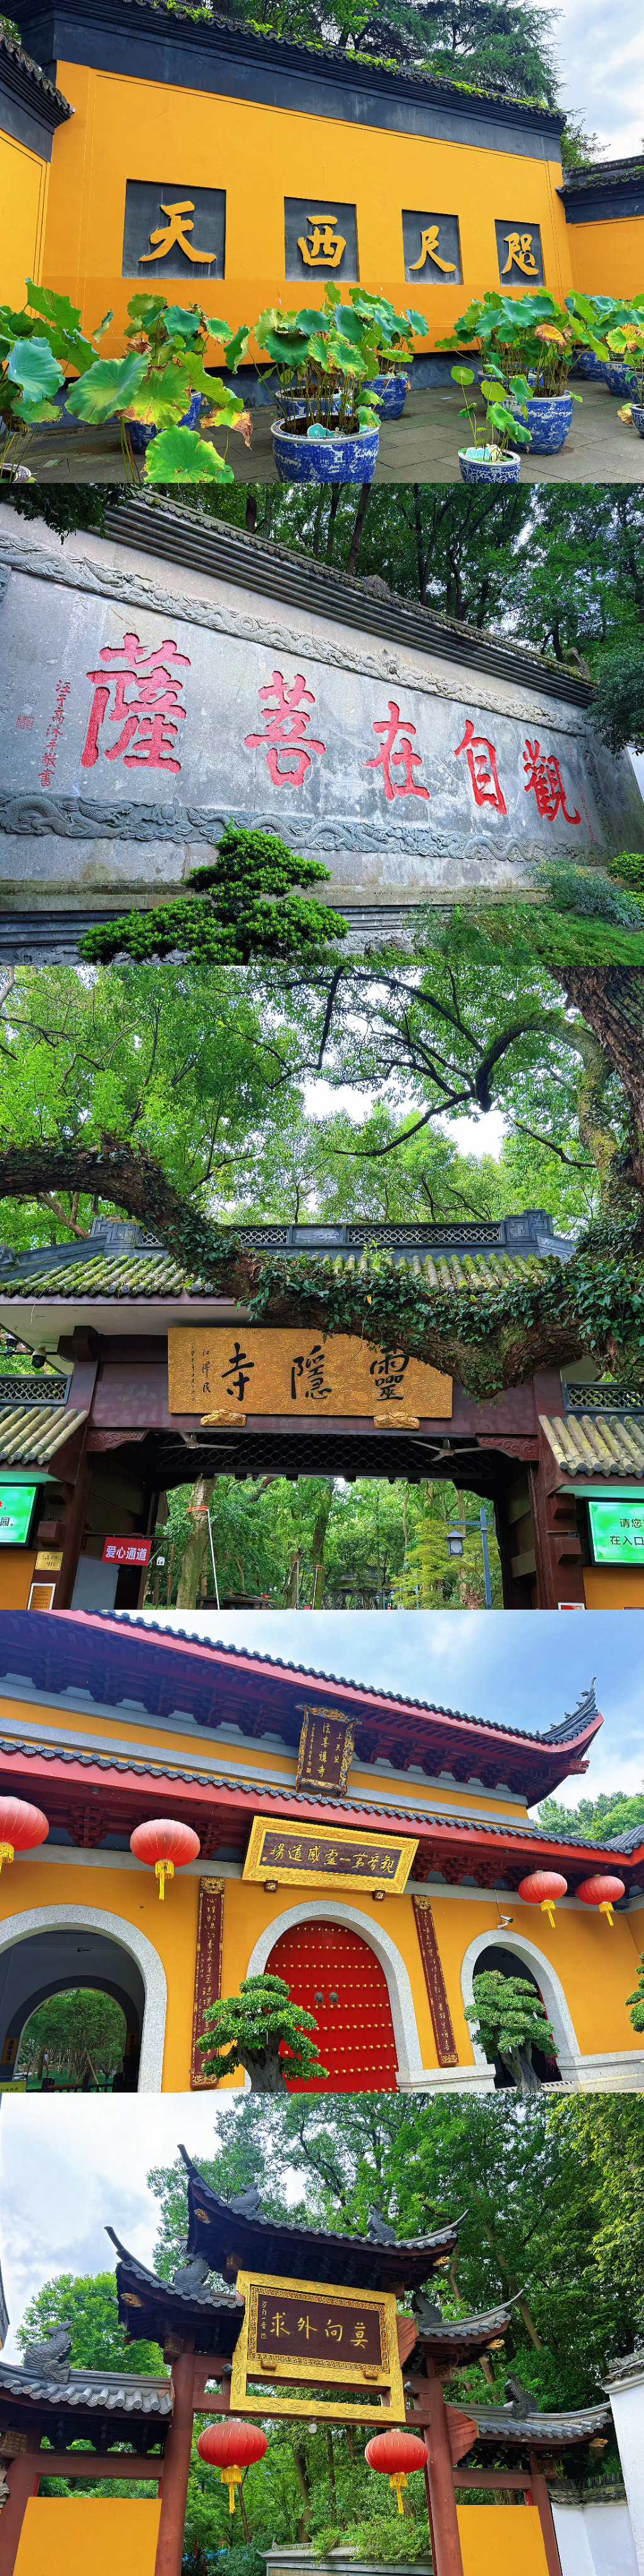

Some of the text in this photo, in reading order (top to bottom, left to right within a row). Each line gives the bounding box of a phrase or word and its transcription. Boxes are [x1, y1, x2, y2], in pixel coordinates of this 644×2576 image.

[138, 200, 540, 277] 咫尺西天
[80, 633, 582, 825] 觀自在菩薩
[619, 1518, 644, 1528] 请您
[106, 1545, 148, 1561] 爱心通道
[269, 2311, 369, 2349] 莫向外求
